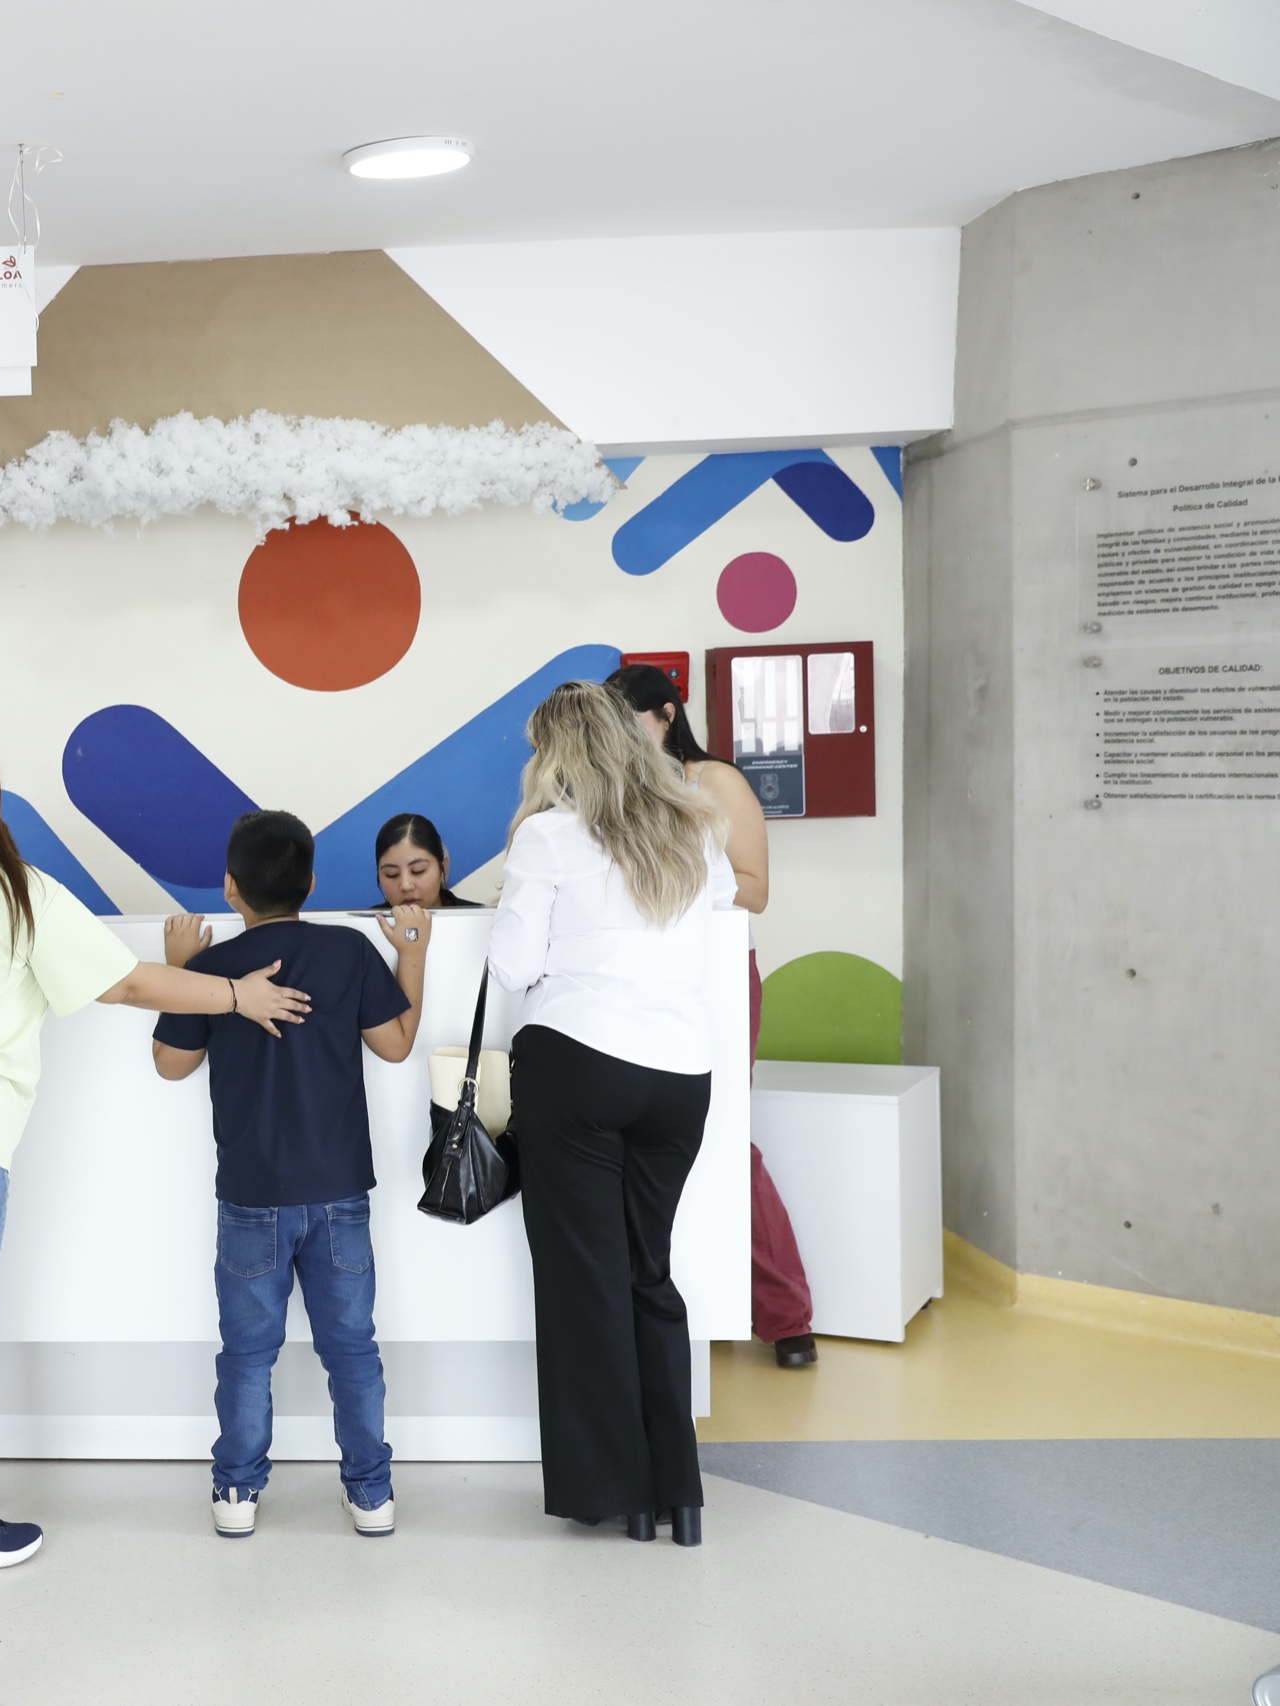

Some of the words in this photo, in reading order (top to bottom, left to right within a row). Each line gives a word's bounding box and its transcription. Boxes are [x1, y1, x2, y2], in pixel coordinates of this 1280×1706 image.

[1117, 490, 1148, 498] Sistema
[1150, 488, 1167, 497] para
[1179, 482, 1220, 492] Desarrollo
[1222, 478, 1254, 489] Integral
[1217, 499, 1248, 508] Calidad
[1158, 666, 1206, 675] OBJETIVOS
[1222, 664, 1263, 673] CALIDAD:
